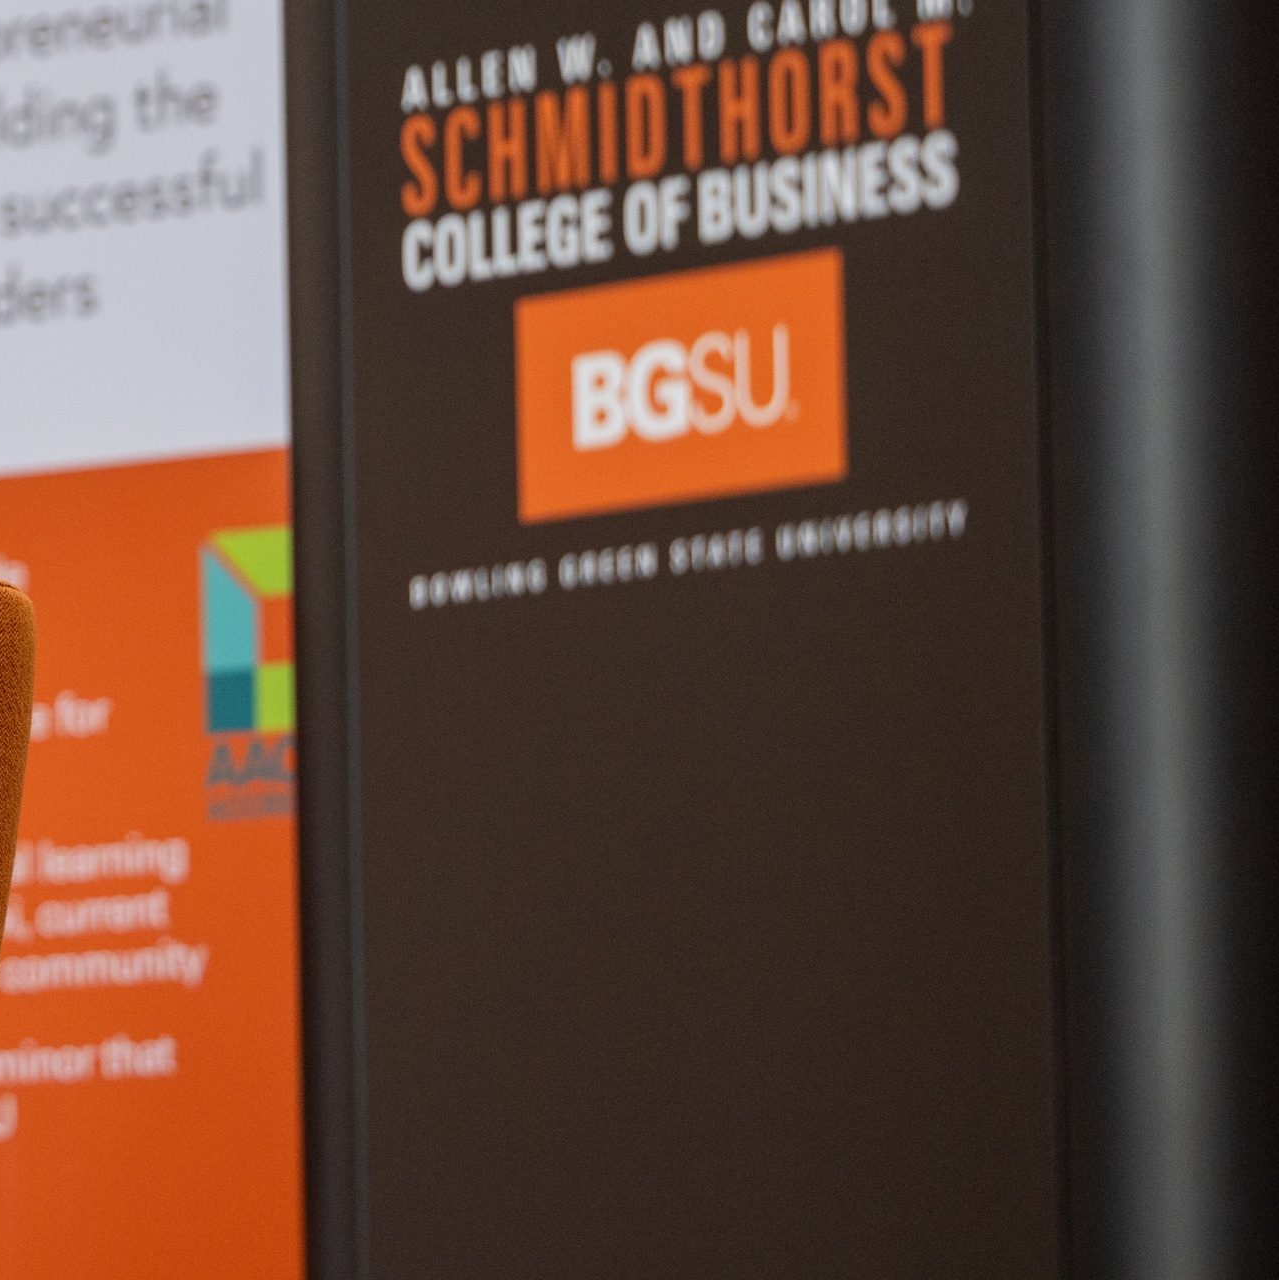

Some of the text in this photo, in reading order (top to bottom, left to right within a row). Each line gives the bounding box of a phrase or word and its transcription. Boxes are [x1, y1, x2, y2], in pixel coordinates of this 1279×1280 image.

[400, 44, 538, 114] ALLEN
[557, 33, 613, 83] W.
[632, 10, 726, 71] AND
[133, 66, 221, 132] the
[399, 19, 952, 218] SCHMIDTHORST
[401, 129, 960, 292] COLLEGE OF BUSINESS
[571, 322, 789, 452] BGSU
[408, 498, 969, 610] BOWLING GREEN STATE UNIVERSITY
[54, 689, 114, 739] for
[204, 735, 296, 789] AAC
[36, 830, 190, 886] learning
[34, 888, 171, 940] current
[98, 1031, 179, 1081] that
